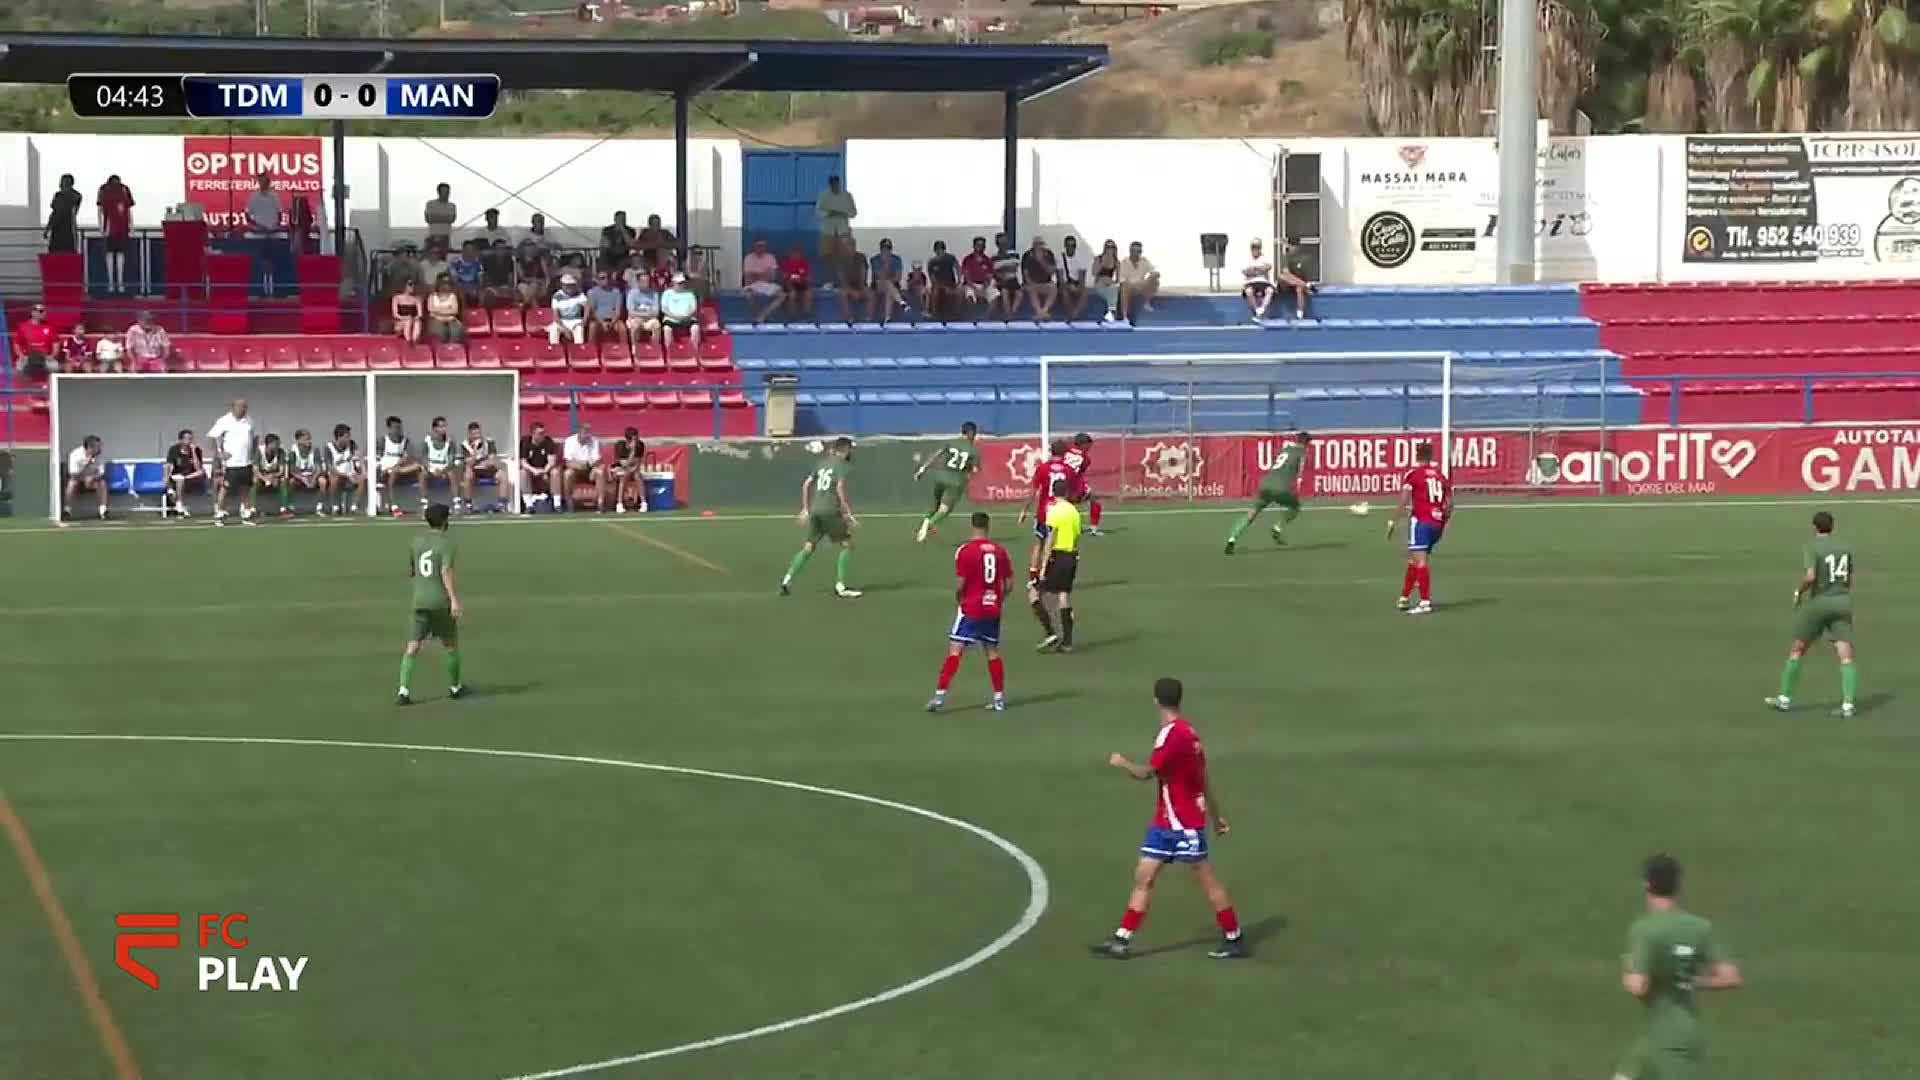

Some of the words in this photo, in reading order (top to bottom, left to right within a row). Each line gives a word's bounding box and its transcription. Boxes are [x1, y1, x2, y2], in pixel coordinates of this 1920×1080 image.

[187, 152, 320, 175] OPTIMUS
[1361, 173, 1418, 184] MASSAI
[1426, 172, 1467, 183] MARA
[1726, 226, 1752, 248] Tlf.
[1757, 226, 1789, 246] 952
[1792, 225, 1823, 246] 540
[1827, 224, 1861, 246] 939
[1310, 438, 1388, 469] TORRE
[1448, 436, 1497, 467] MAR
[816, 469, 833, 491] 16
[1314, 475, 1380, 493] FUNDADO
[1383, 473, 1401, 492] EN
[1427, 478, 1443, 503] 14
[1628, 482, 1662, 494] TORRE
[1665, 482, 1684, 493] DEL
[1687, 480, 1715, 493] MAR
[420, 550, 433, 577] 6
[984, 553, 996, 584] 8
[1824, 553, 1849, 583] 14
